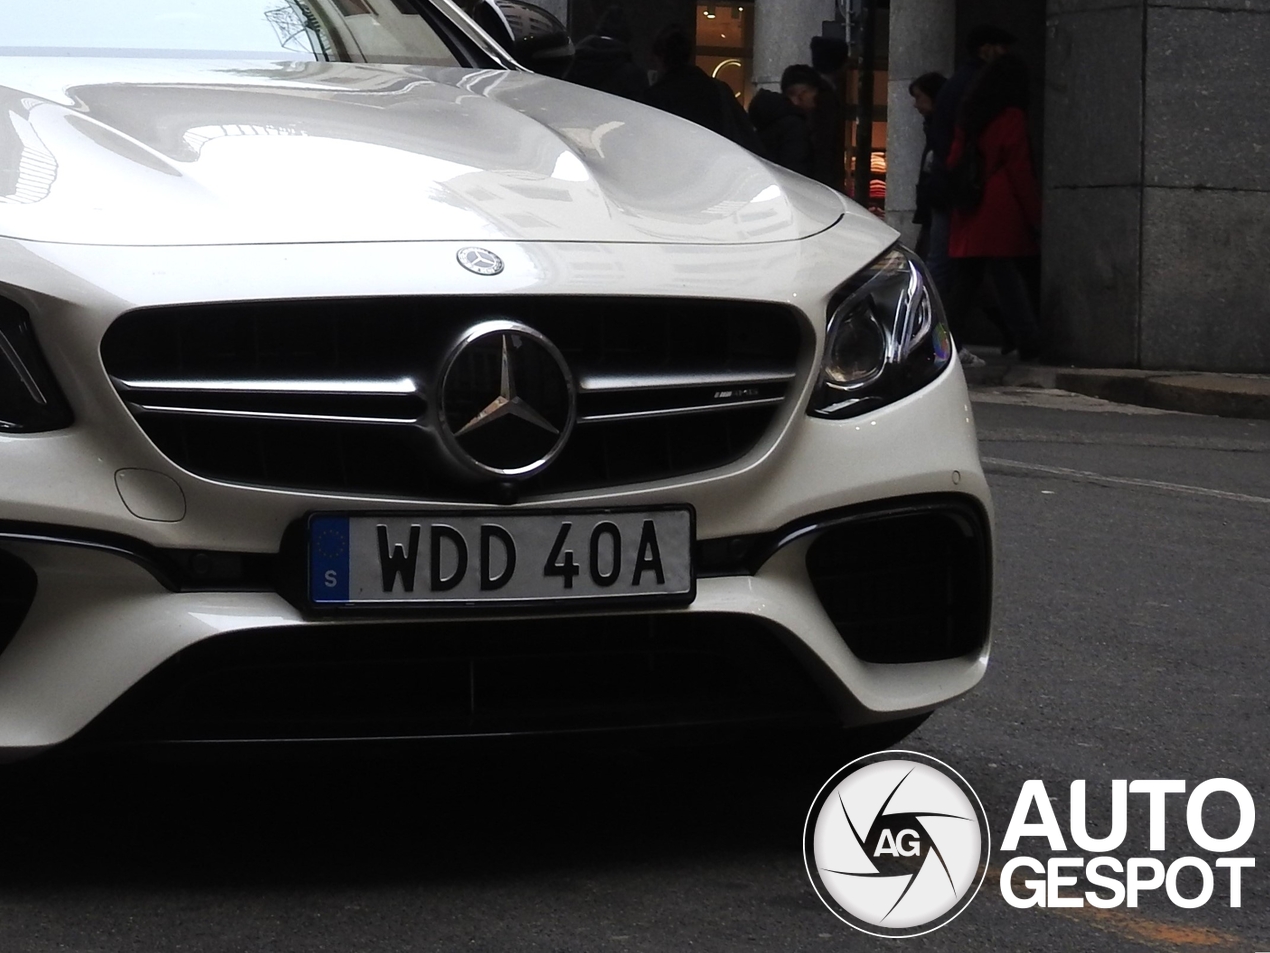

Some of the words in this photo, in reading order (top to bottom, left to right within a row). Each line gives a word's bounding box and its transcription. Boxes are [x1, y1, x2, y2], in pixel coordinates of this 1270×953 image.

[324, 569, 337, 588] S
[376, 523, 517, 593] WDD
[543, 518, 666, 590] 40A
